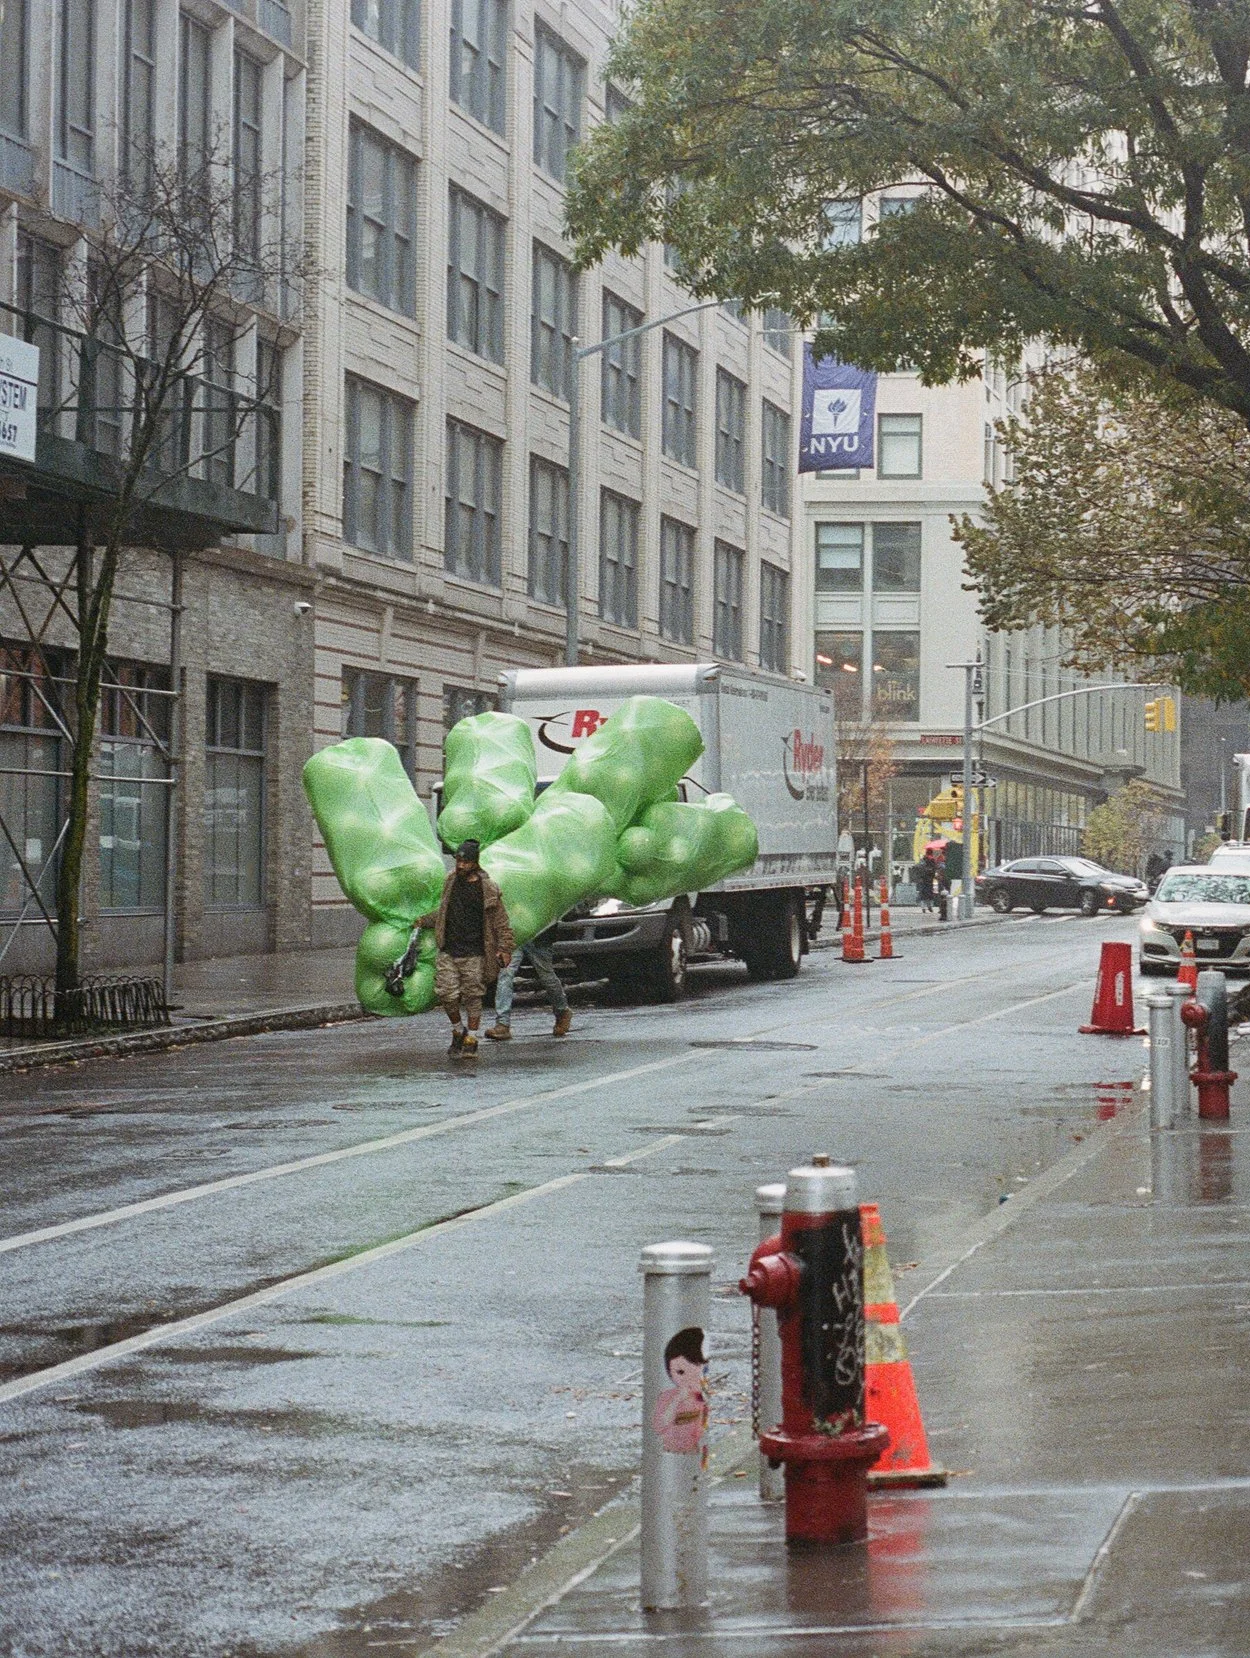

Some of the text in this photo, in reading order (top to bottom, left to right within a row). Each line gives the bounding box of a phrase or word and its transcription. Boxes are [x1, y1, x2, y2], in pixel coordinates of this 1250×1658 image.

[810, 435, 859, 454] NYU
[877, 680, 916, 701] blink
[793, 728, 825, 783] Ryder
